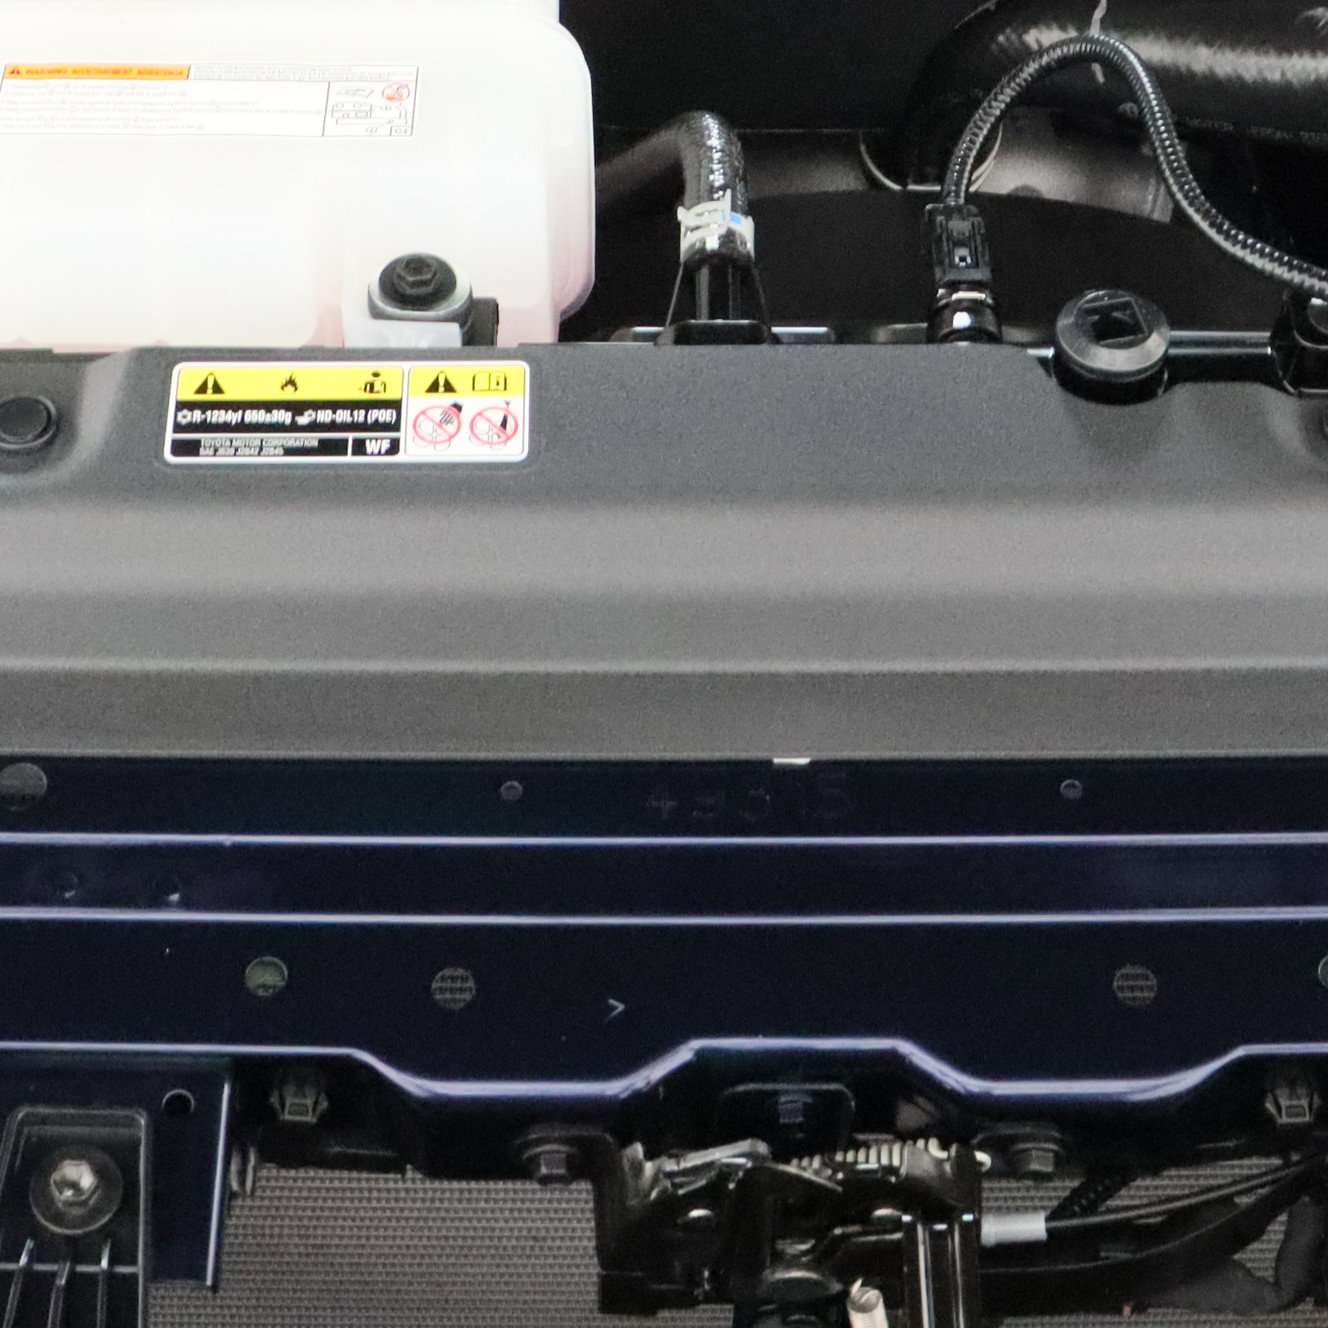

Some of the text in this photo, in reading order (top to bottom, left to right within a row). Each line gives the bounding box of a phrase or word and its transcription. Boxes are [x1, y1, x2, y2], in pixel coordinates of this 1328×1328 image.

[367, 409, 397, 426] (POE)
[200, 438, 319, 447] TOYOTA MOTOR CORPORATION
[366, 439, 391, 455] WF
